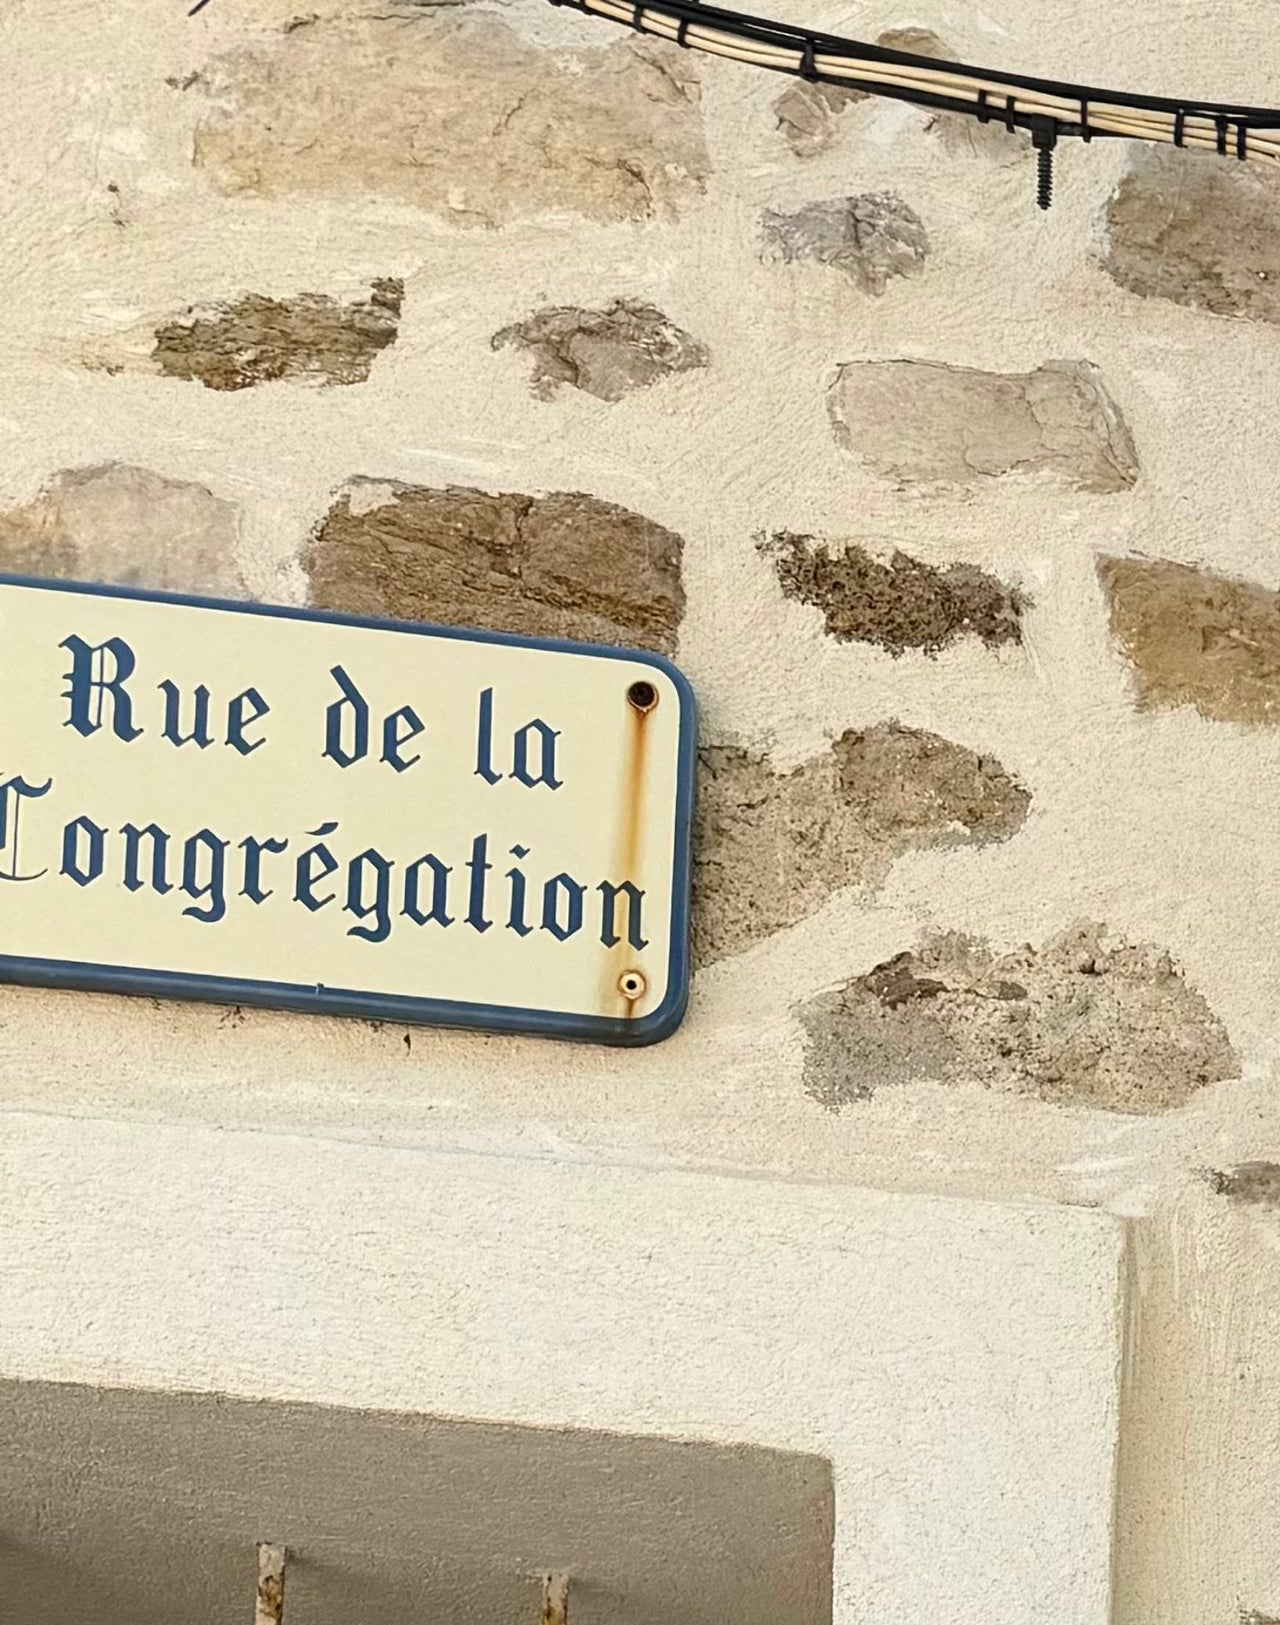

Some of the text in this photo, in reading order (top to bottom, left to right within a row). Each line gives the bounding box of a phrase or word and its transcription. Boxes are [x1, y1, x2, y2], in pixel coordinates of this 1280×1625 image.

[58, 633, 564, 791] Rue de la
